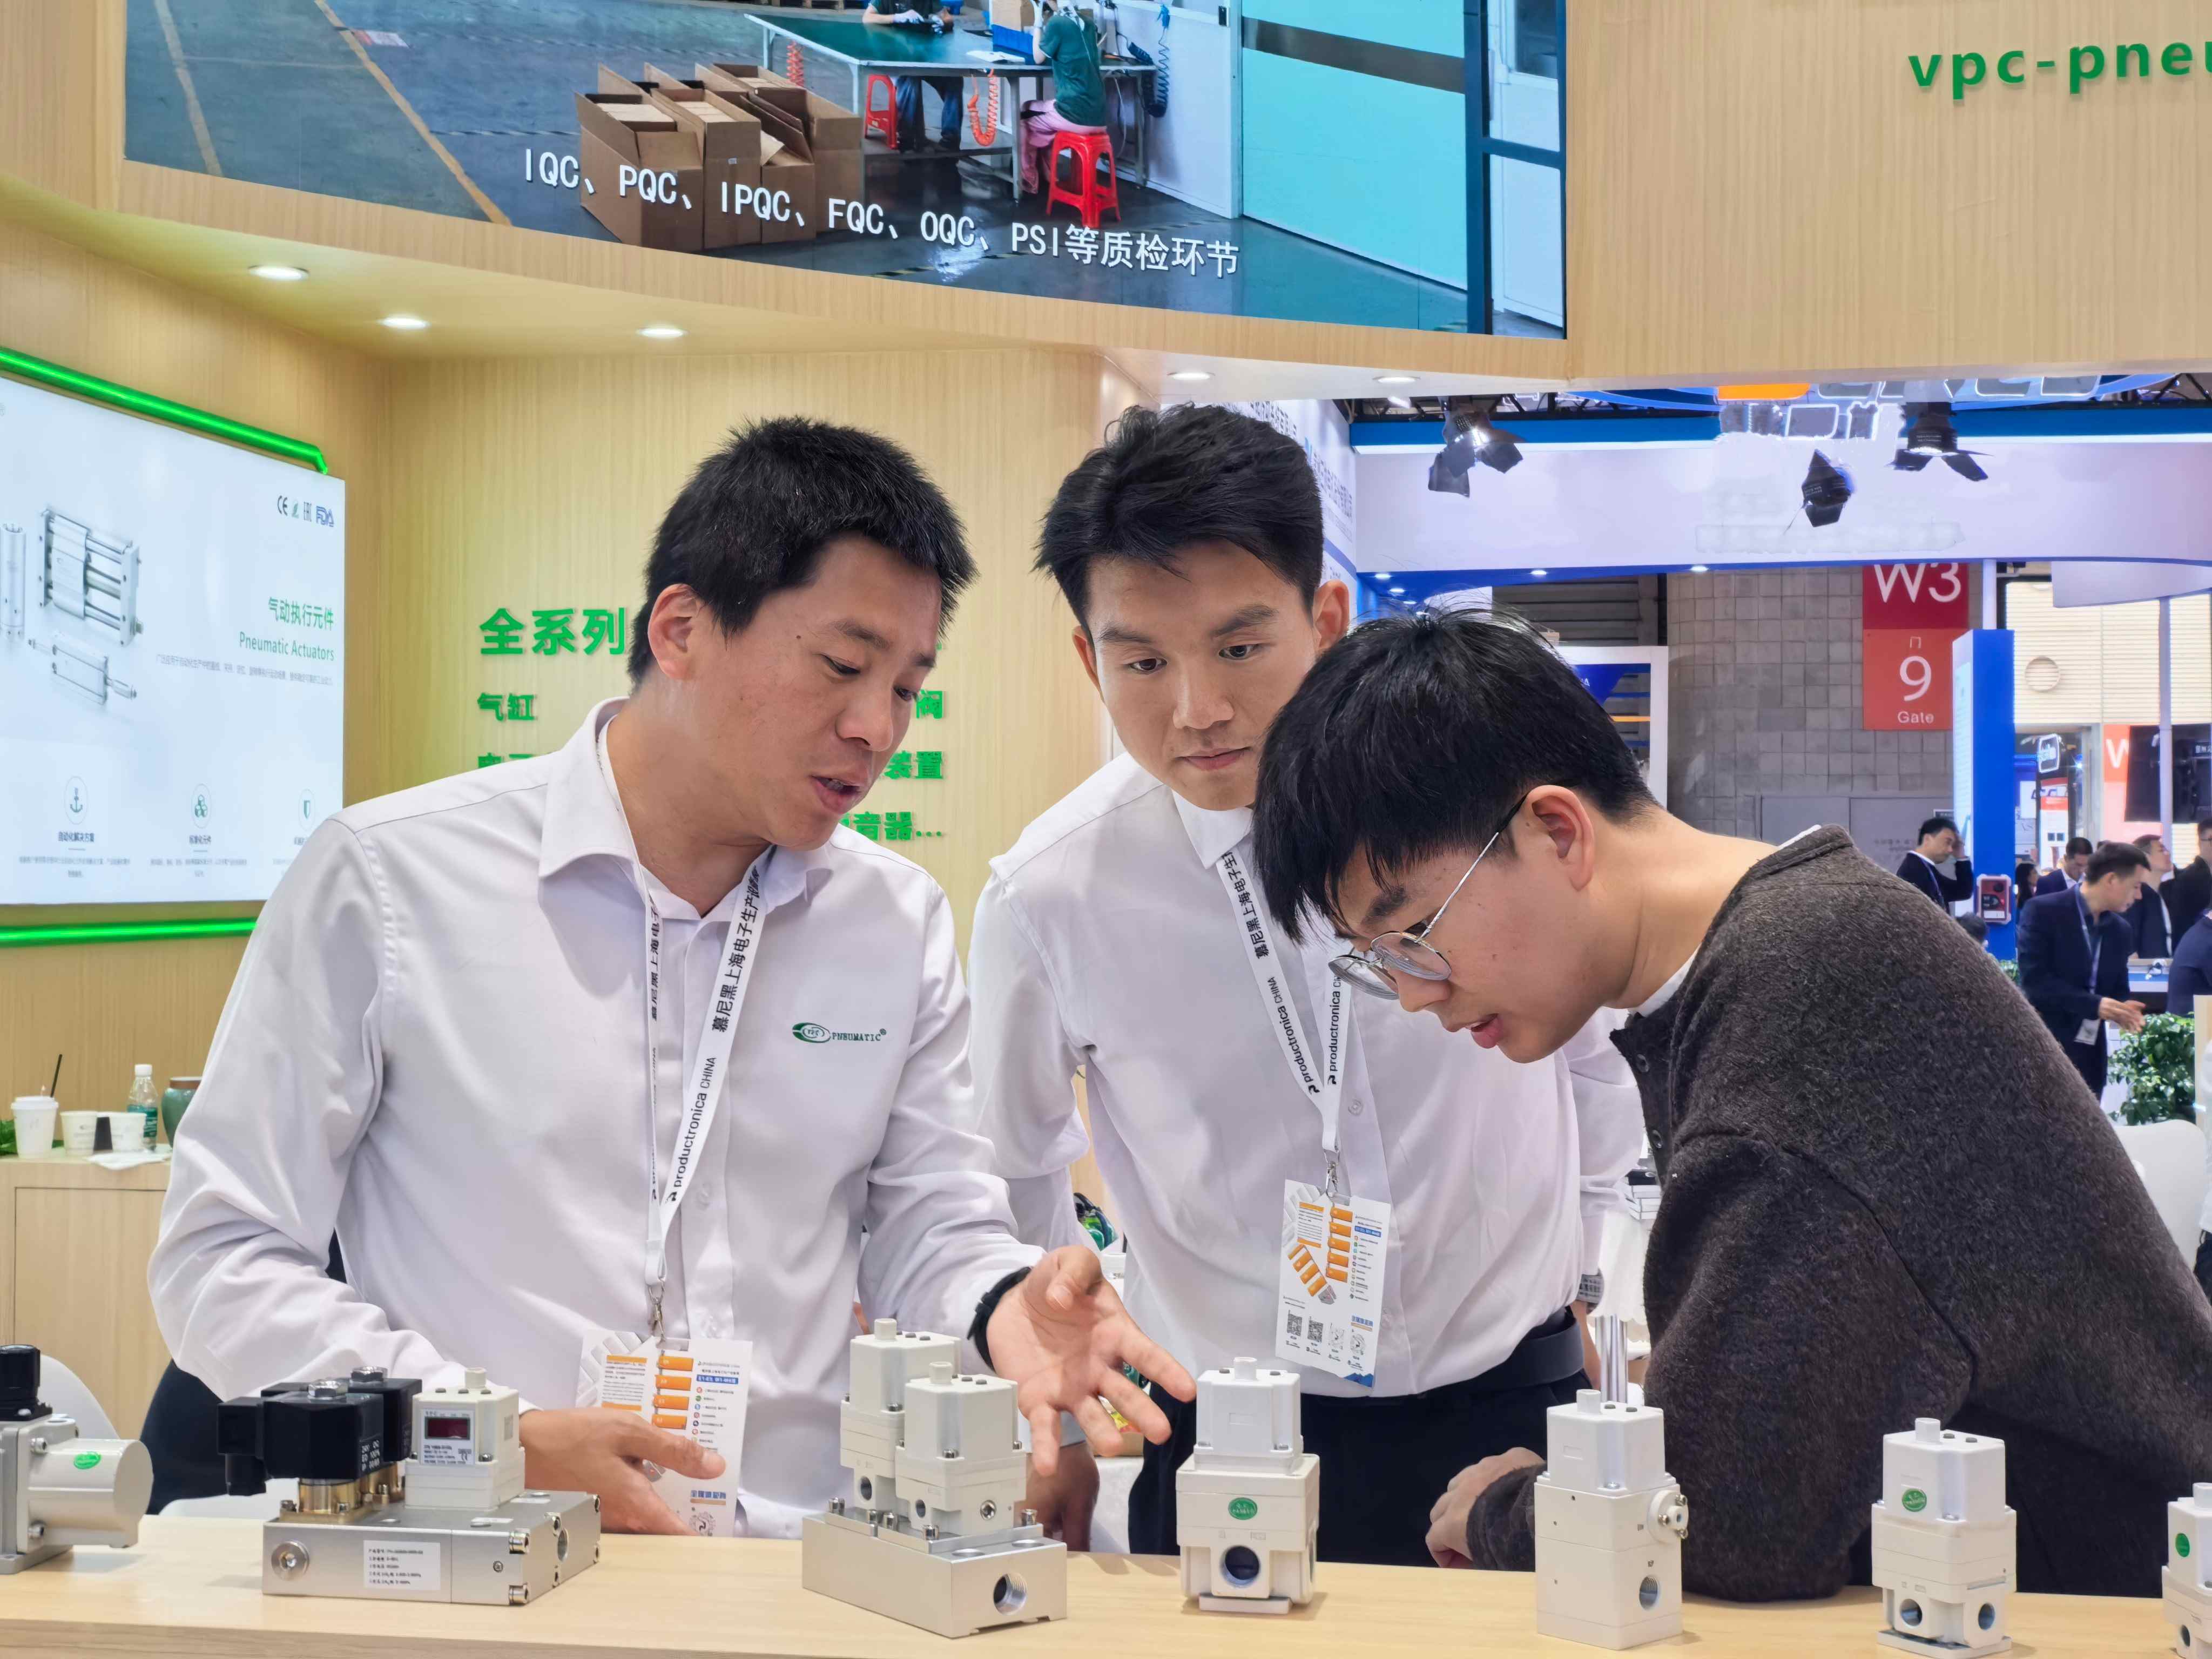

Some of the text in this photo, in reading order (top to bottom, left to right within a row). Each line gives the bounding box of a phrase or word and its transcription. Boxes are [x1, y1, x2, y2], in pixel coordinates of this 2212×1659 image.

[1908, 41, 2212, 100] vpc-pne
[1873, 562, 1962, 603] W3
[268, 596, 334, 631] 气动执行元件
[239, 631, 334, 662] Pneumatic Actuators
[1899, 655, 1932, 702] 9
[477, 692, 535, 721] 气缸
[1897, 711, 1934, 724] Gate
[1267, 976, 1313, 1087] productronica CHINA
[1328, 990, 1341, 1072] productronica
[673, 1056, 717, 1188] productronica CHINA
